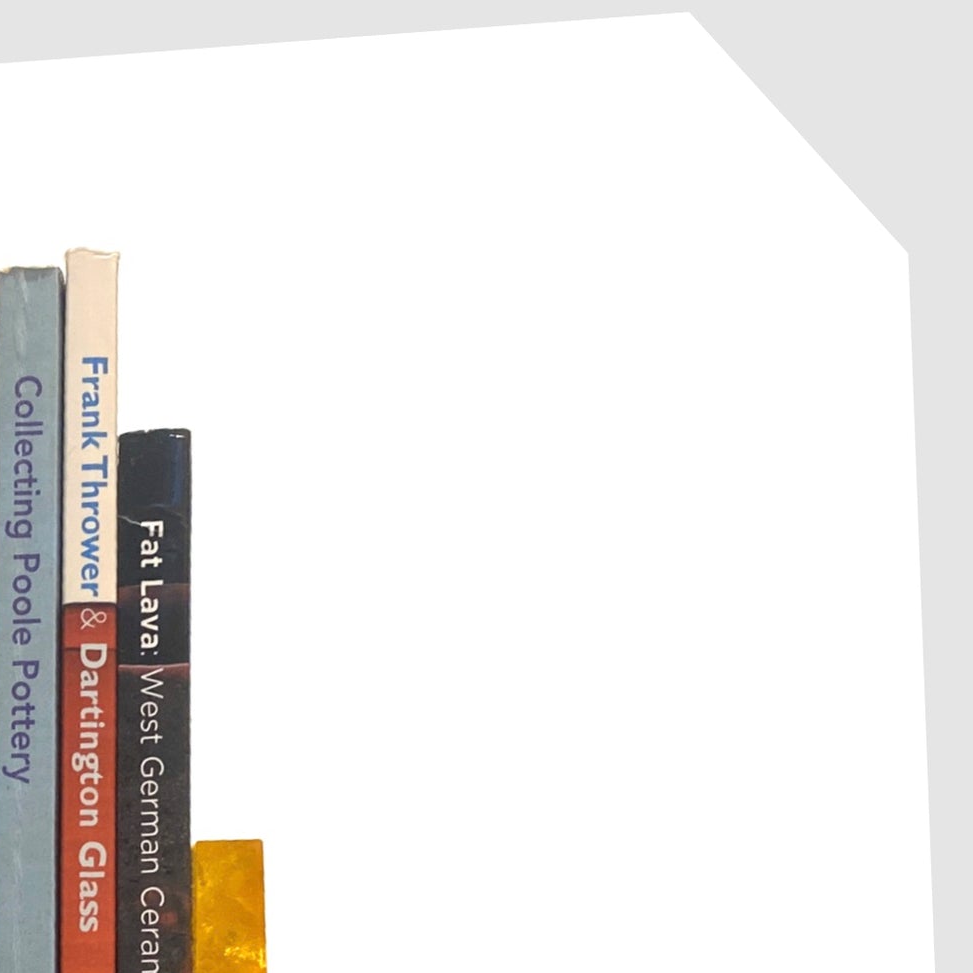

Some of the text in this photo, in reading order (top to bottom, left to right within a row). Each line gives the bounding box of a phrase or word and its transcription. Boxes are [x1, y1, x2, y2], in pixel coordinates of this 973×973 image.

[2, 375, 43, 785] Collecting Poole Pottery
[140, 519, 164, 570] Fat
[71, 356, 109, 933] Frank Thrower & Dartington Glass
[140, 576, 164, 656] Lava:
[140, 666, 165, 744] West
[140, 756, 165, 874] German
